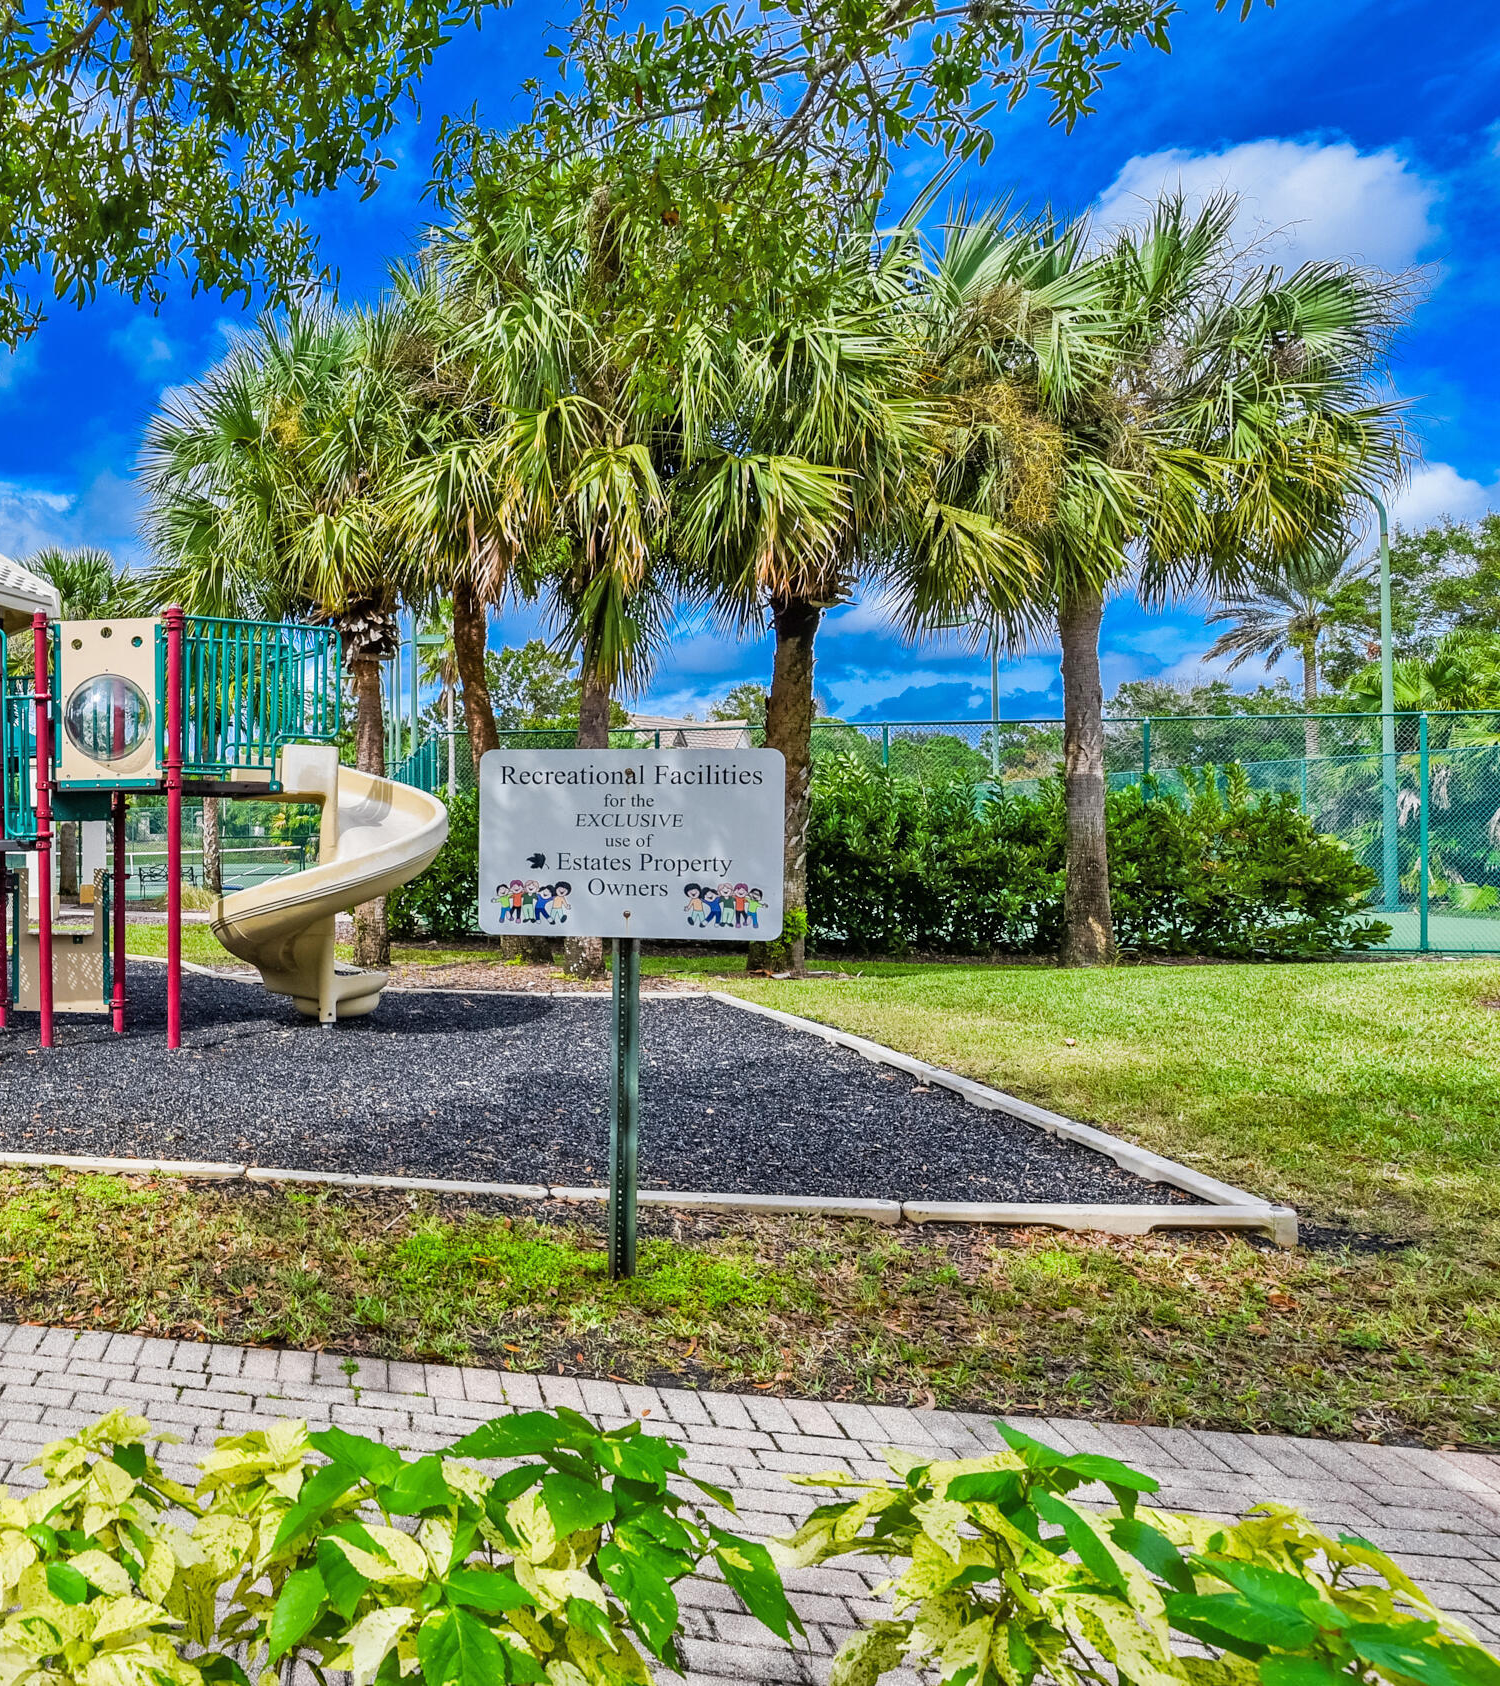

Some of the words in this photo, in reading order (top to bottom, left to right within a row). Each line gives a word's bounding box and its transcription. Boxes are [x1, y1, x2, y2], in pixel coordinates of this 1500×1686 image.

[500, 765, 644, 785] Recreational
[654, 765, 762, 785] Facilities
[604, 794, 626, 807] for
[631, 794, 654, 807] the
[576, 814, 683, 827] EXCLUSIVE
[606, 838, 630, 847] use
[636, 834, 654, 847] of
[557, 853, 631, 871] Estates
[639, 854, 732, 877] Property
[588, 878, 668, 896] Owners
